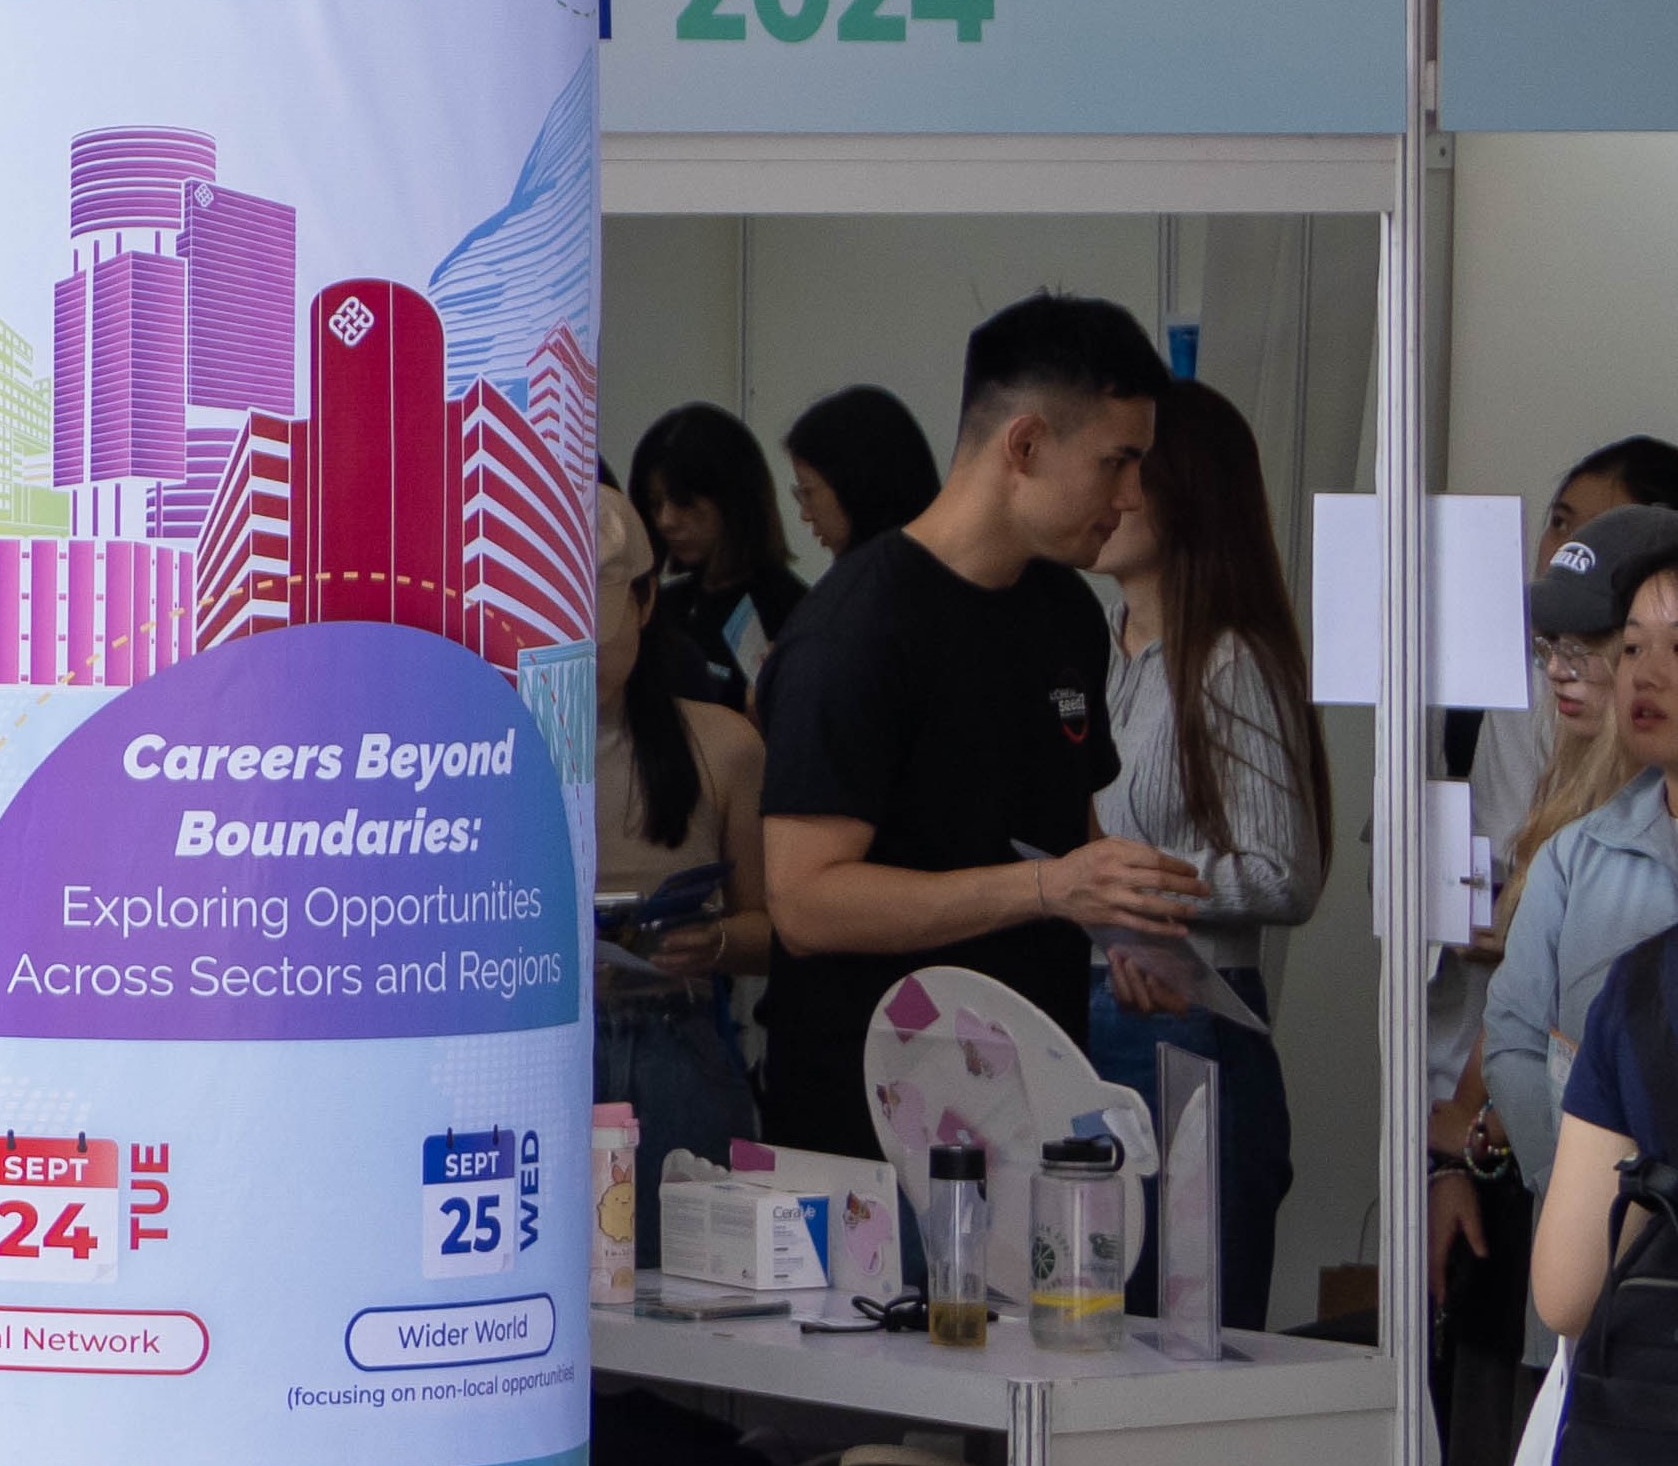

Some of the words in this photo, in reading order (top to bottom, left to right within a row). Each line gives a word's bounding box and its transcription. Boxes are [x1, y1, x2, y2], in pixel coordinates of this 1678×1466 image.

[122, 734, 341, 783] Careers
[357, 729, 514, 790] Beyond
[176, 808, 482, 858] Boundaries:
[64, 884, 289, 937] Exploring
[304, 880, 542, 933] Opportunities
[7, 954, 173, 997] Across
[189, 954, 362, 996] Sectors
[376, 952, 446, 993] and
[459, 948, 561, 998] Regions
[4, 1155, 89, 1182] SEPT
[445, 1148, 500, 1177] SEPT
[130, 1143, 169, 1250] TUE
[519, 1129, 539, 1252] WED
[772, 1204, 817, 1220] CeraVe
[439, 1195, 501, 1256] 25
[23, 1326, 161, 1355] Network
[397, 1320, 467, 1350] Wider
[475, 1314, 528, 1344] World
[286, 1385, 384, 1410] (focusing
[391, 1384, 415, 1403] on
[421, 1380, 498, 1401] non-local
